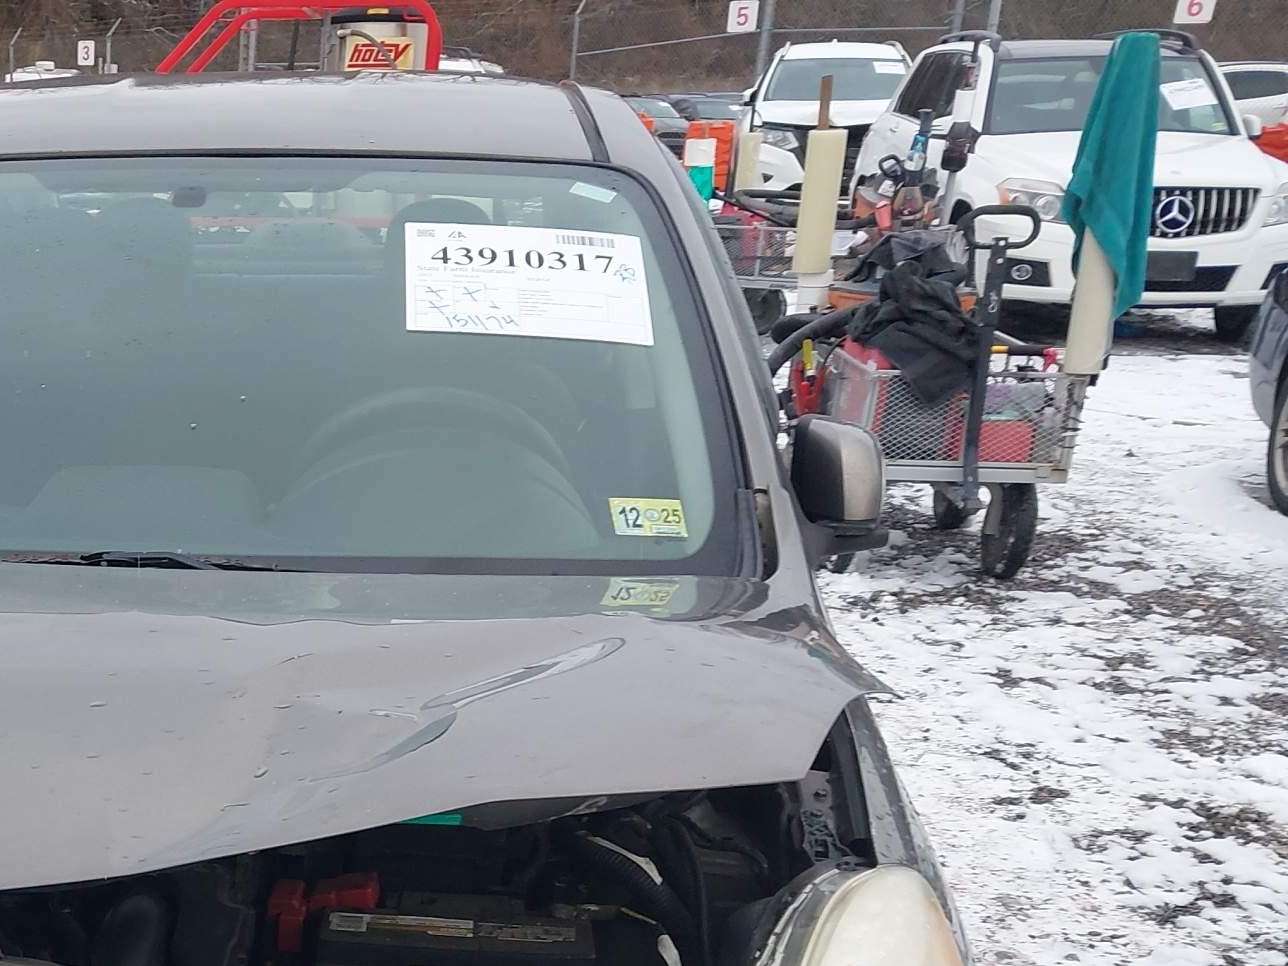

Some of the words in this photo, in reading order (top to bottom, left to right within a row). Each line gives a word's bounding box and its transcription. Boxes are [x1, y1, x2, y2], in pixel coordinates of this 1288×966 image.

[737, 6, 750, 26] 5
[1188, 0, 1203, 17] 6
[82, 45, 90, 61] 3
[430, 246, 614, 273] 43910317
[619, 506, 644, 529] 12
[661, 508, 681, 524] 25
